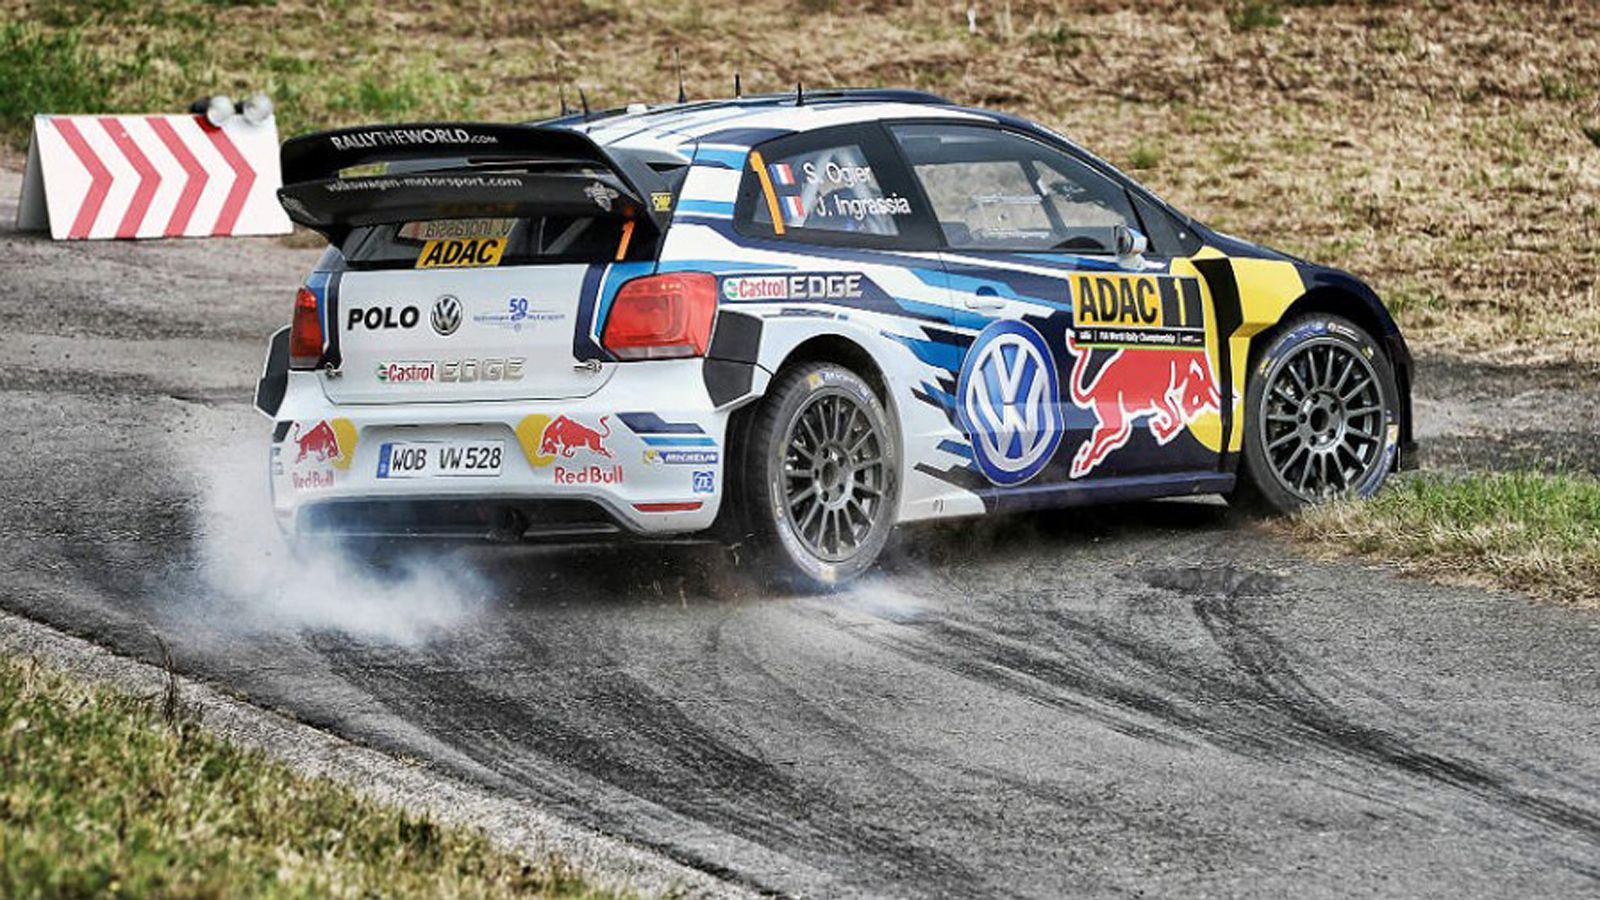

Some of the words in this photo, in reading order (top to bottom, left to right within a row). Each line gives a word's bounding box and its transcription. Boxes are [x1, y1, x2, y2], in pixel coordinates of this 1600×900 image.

[325, 176, 523, 193] volkswagen-motorsport.com
[803, 162, 824, 184] S.
[827, 162, 872, 187] Ogier
[816, 195, 832, 217] J.
[834, 192, 912, 220] Ingrassia
[424, 240, 499, 266] ADAC
[738, 278, 786, 298] Castrol
[789, 275, 863, 298] EDGE
[509, 298, 529, 313] 50
[1078, 276, 1158, 323] ADAC
[1174, 277, 1187, 327] 1
[347, 305, 420, 331] POLO
[388, 361, 435, 383] Castrol
[438, 358, 526, 383] EDGE
[392, 448, 426, 471] WOB
[465, 446, 502, 469] 528
[665, 452, 717, 463] MICHELIN
[554, 466, 587, 484] Red
[590, 465, 624, 484] Bull
